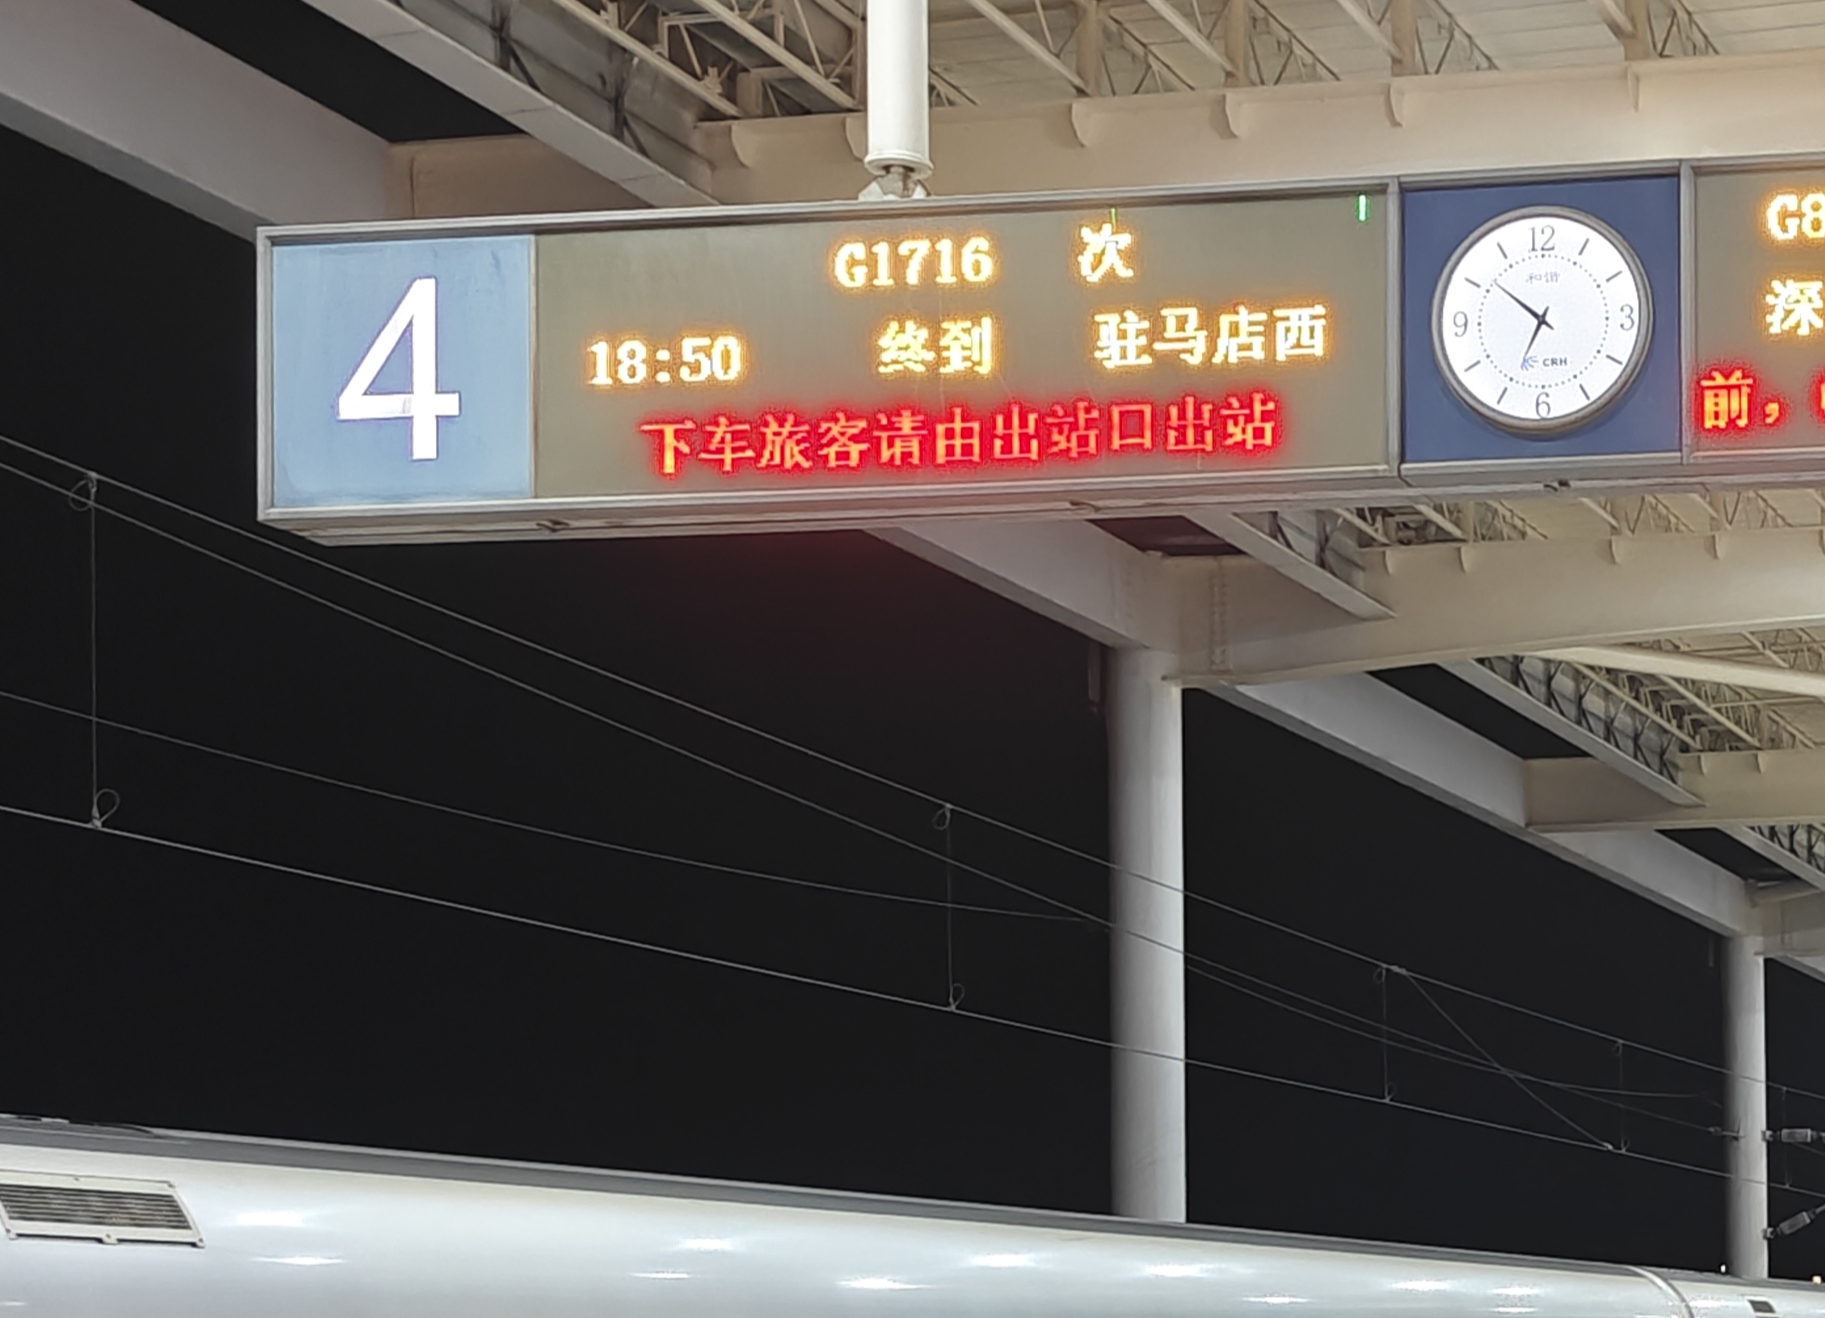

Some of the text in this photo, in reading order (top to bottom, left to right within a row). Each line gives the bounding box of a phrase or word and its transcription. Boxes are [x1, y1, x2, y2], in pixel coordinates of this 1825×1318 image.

[1528, 225, 1556, 252] 12
[833, 221, 1135, 289] G1716 次
[1453, 311, 1469, 338] 9
[1619, 304, 1635, 331] 3
[586, 303, 1329, 386] 18:50 终到 驻马店西
[336, 276, 461, 461] 4
[1542, 356, 1568, 368] CRH
[1535, 392, 1551, 419] 6
[638, 392, 1278, 477] 下车旅客请由出站口出站
